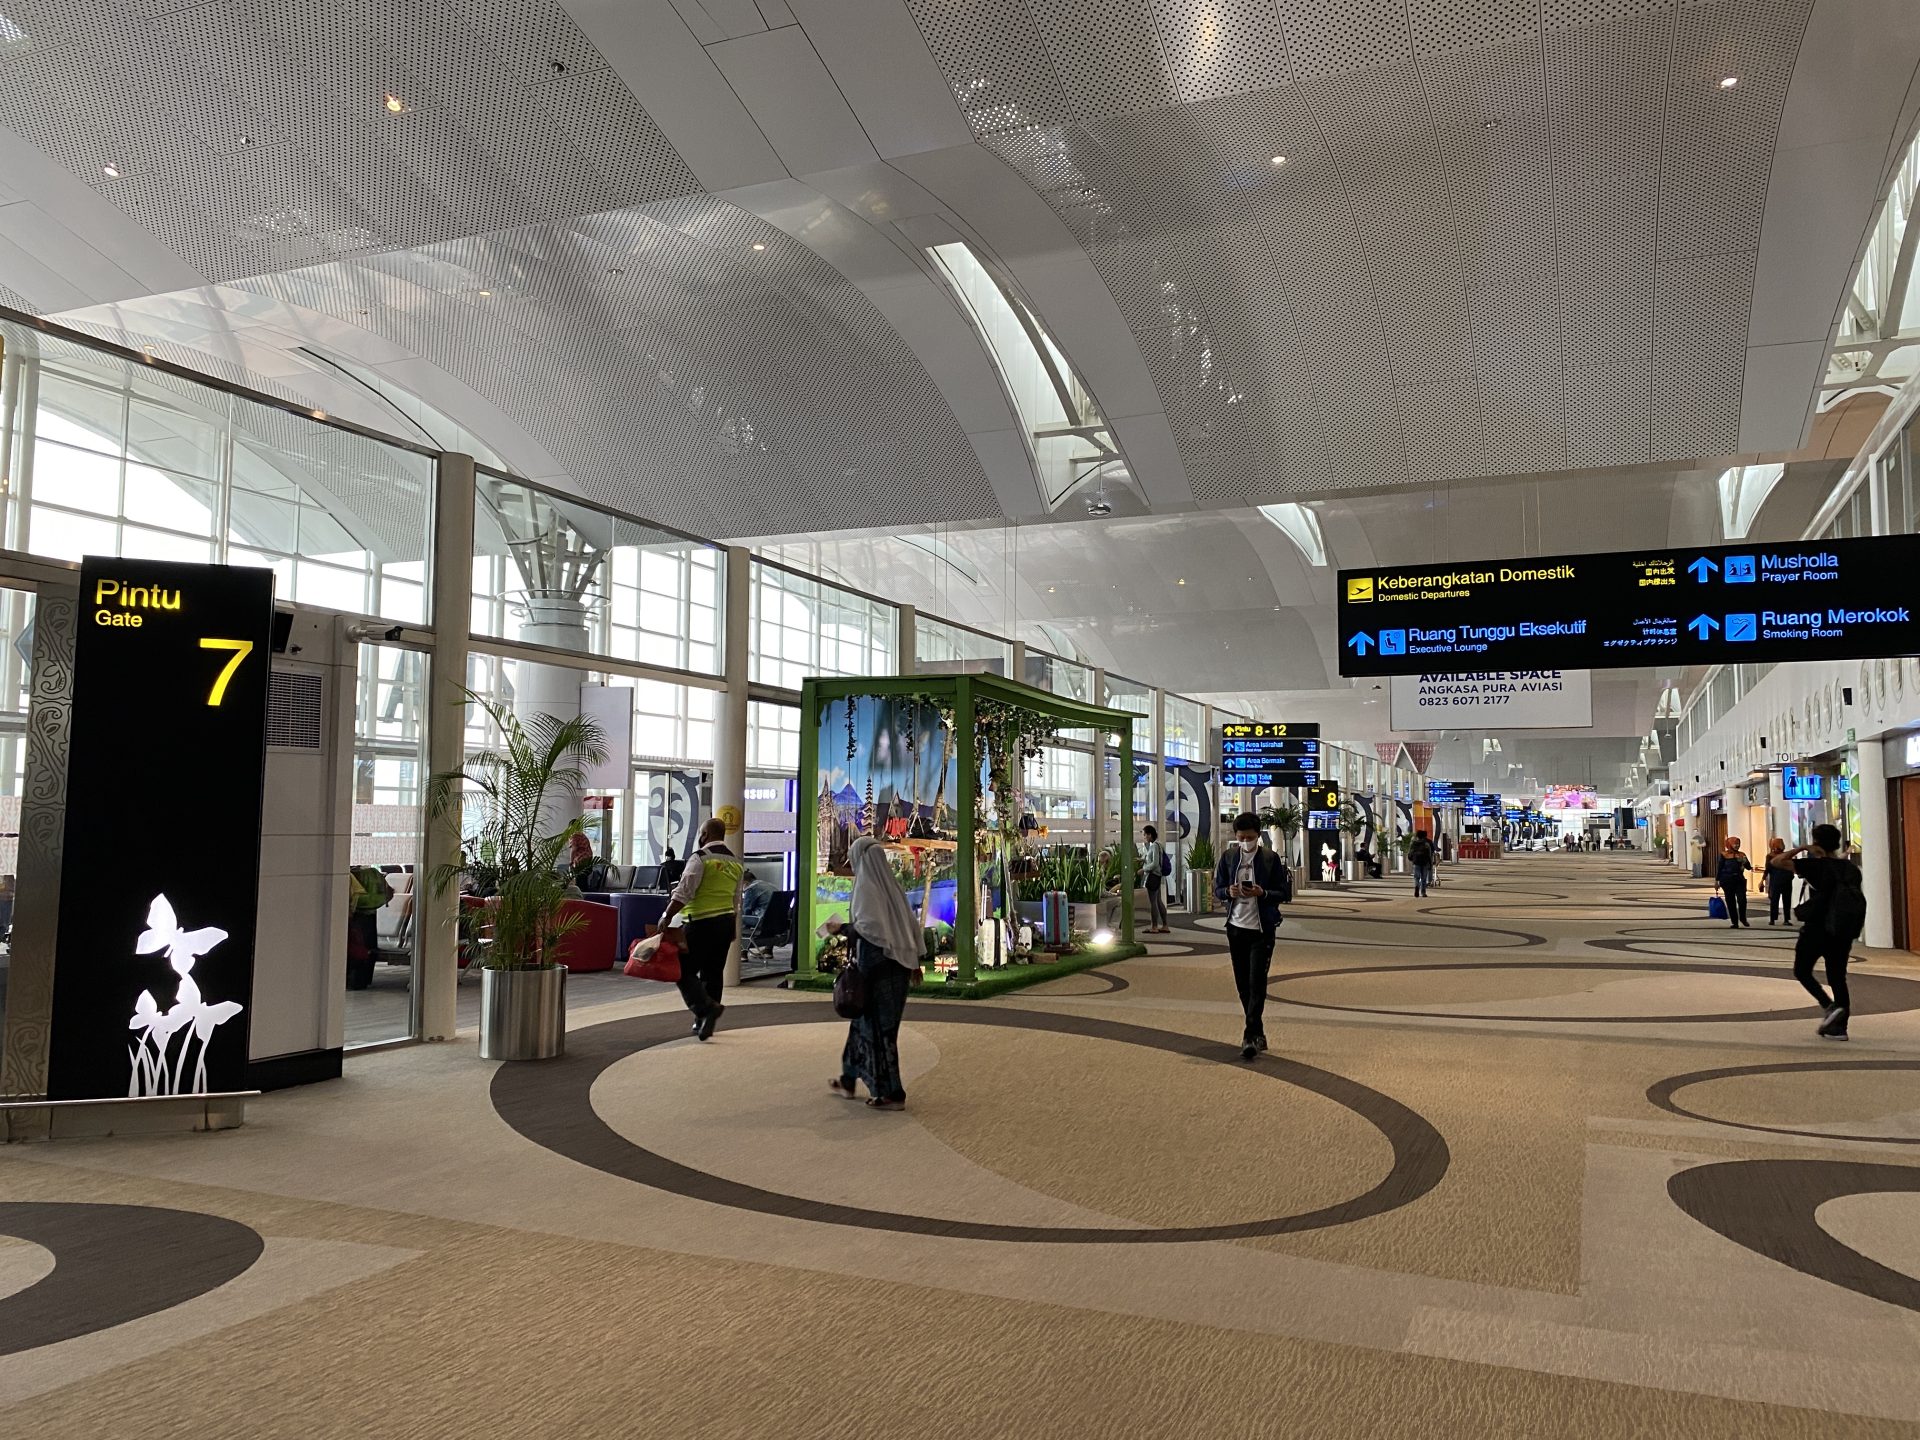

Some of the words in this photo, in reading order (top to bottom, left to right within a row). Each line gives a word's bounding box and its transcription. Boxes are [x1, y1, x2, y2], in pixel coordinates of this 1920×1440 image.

[1762, 553, 1838, 569] Musholla
[1378, 572, 1495, 589] Keberangkatan
[1500, 566, 1576, 582] Domestik
[1762, 572, 1800, 582] Prayer
[1804, 570, 1838, 580] Room
[95, 579, 181, 610] Pintu
[1379, 592, 1419, 601] Domestic
[1421, 590, 1470, 601] Departures
[95, 610, 142, 627] Gate
[1762, 611, 1822, 628] Ruang
[1828, 607, 1910, 624] Merokok
[1409, 628, 1456, 642] Ruang
[1459, 625, 1515, 639] Tunggu
[1520, 620, 1587, 636] Eksekutif
[1763, 630, 1808, 640] Smoking
[1812, 628, 1842, 637] Room
[1410, 644, 1451, 654] Executive
[1455, 643, 1487, 653] Lounge
[200, 638, 253, 706] 7
[1419, 671, 1504, 682] AVAILABLE
[1510, 670, 1561, 680] SPACE
[1419, 685, 1478, 694] ANGKASA
[1483, 684, 1516, 692] PURA
[1521, 682, 1562, 691] AVIASI
[1419, 696, 1448, 706] 0823
[1453, 696, 1479, 705] 6071
[1484, 695, 1509, 704] 2177
[1255, 726, 1263, 736] 8
[1272, 725, 1286, 735] 12
[1776, 752, 1809, 762] TOILET
[1327, 793, 1336, 807] 8
